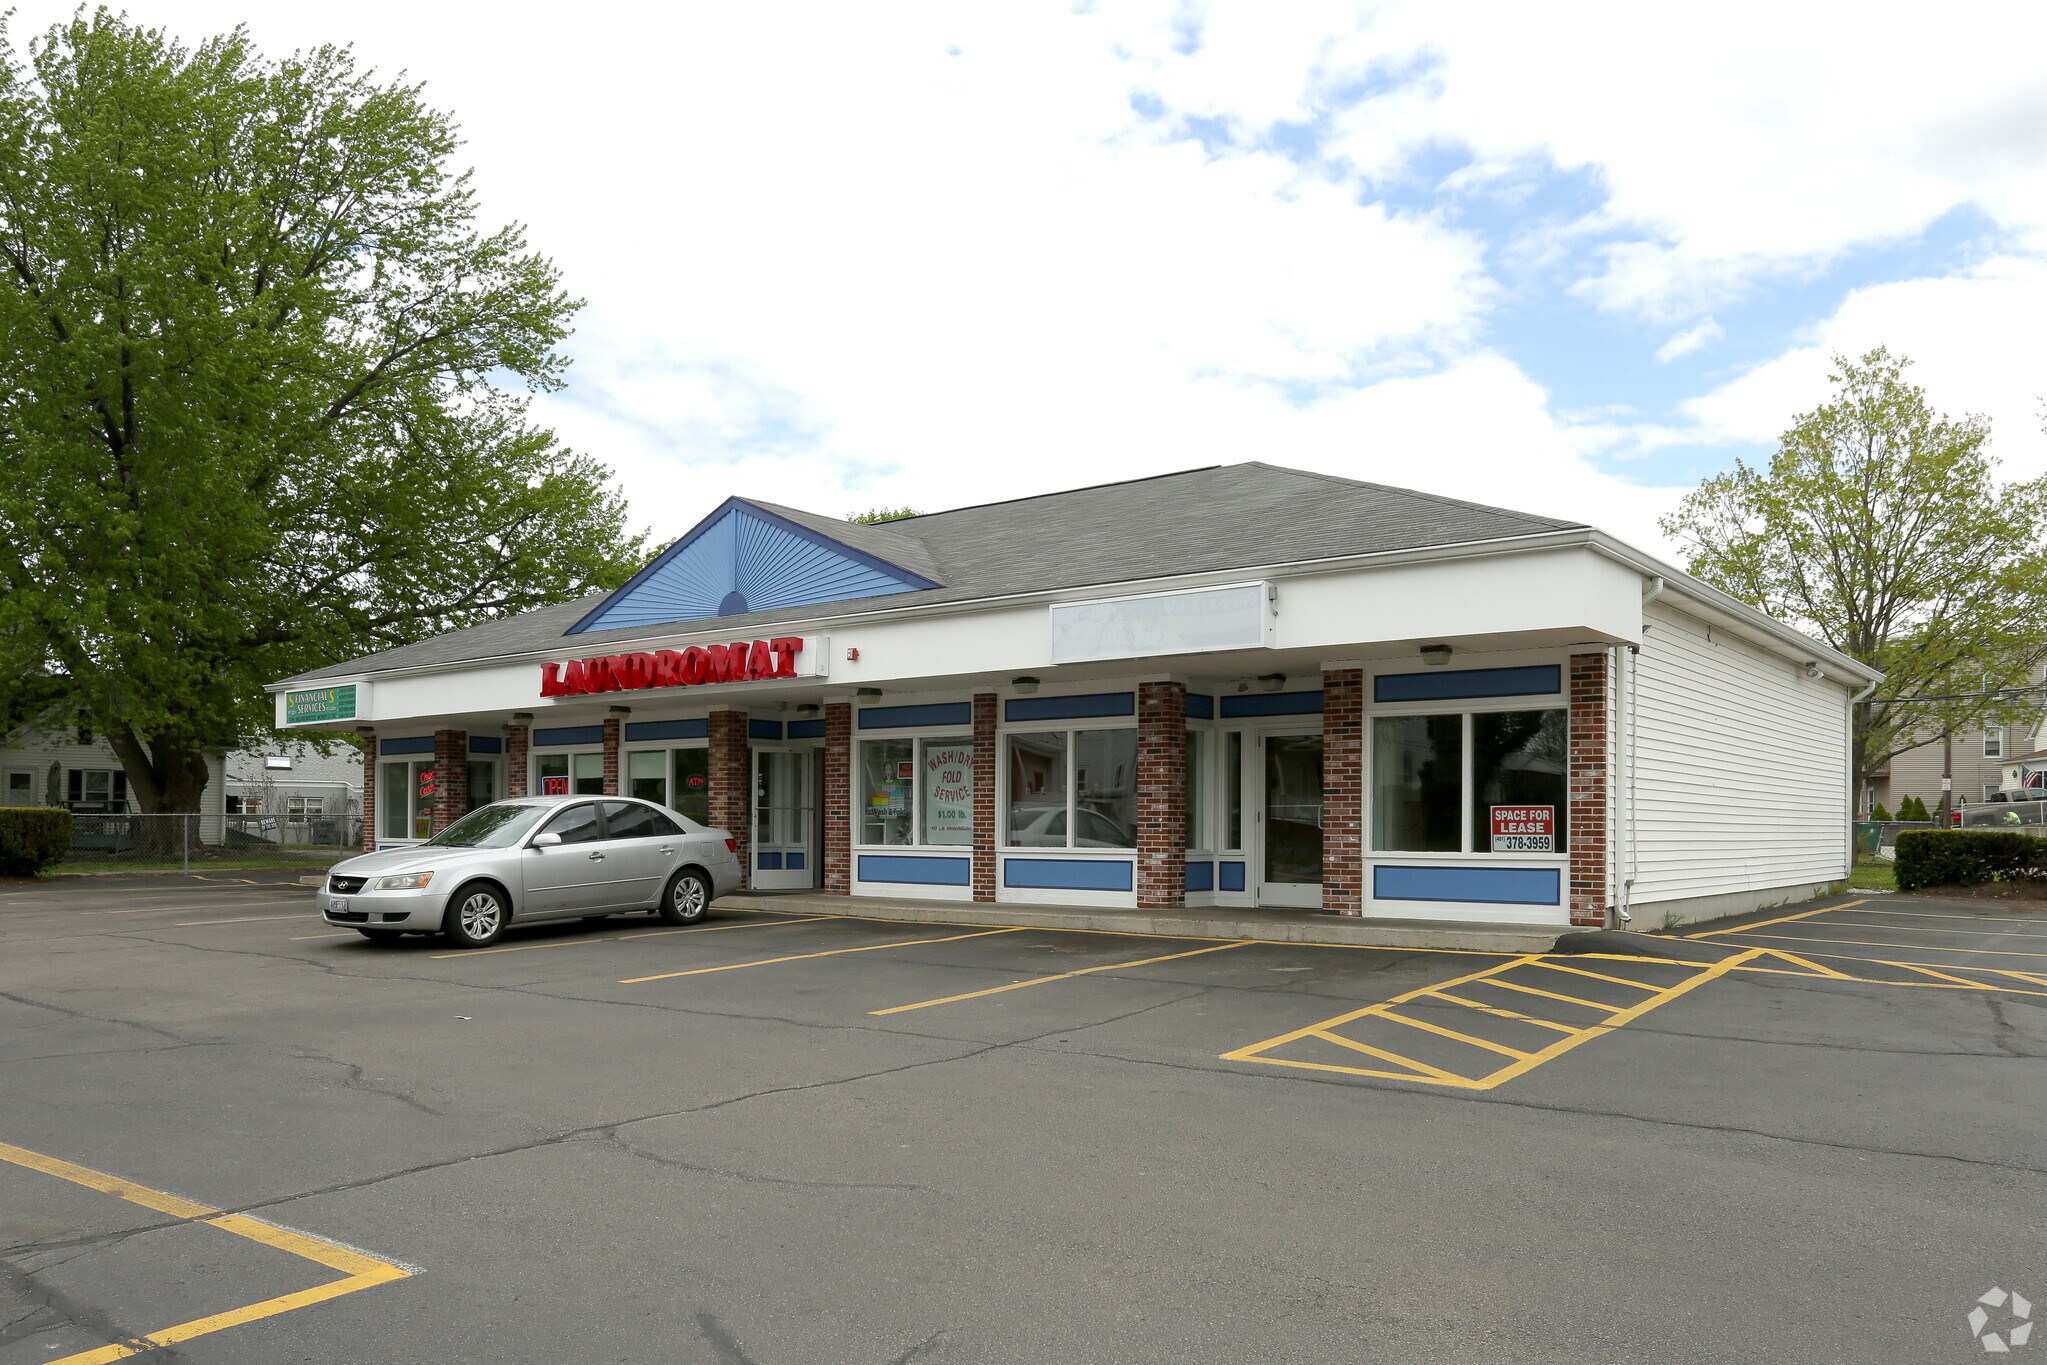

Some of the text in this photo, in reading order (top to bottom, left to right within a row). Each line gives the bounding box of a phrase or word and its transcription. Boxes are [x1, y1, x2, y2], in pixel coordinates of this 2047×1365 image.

[540, 637, 804, 698] LAUNDROMAT
[295, 692, 328, 703] FINANCIAL
[297, 702, 326, 714] SERVICES
[688, 778, 704, 786] ATM
[942, 770, 962, 784] FOLD
[933, 785, 970, 803] SERVICE
[871, 808, 887, 816] Wash
[937, 809, 956, 819] $1.00
[1495, 810, 1550, 821] SPACE FOR
[1500, 822, 1545, 833] LEASE
[1506, 836, 1550, 850] 378-3959
